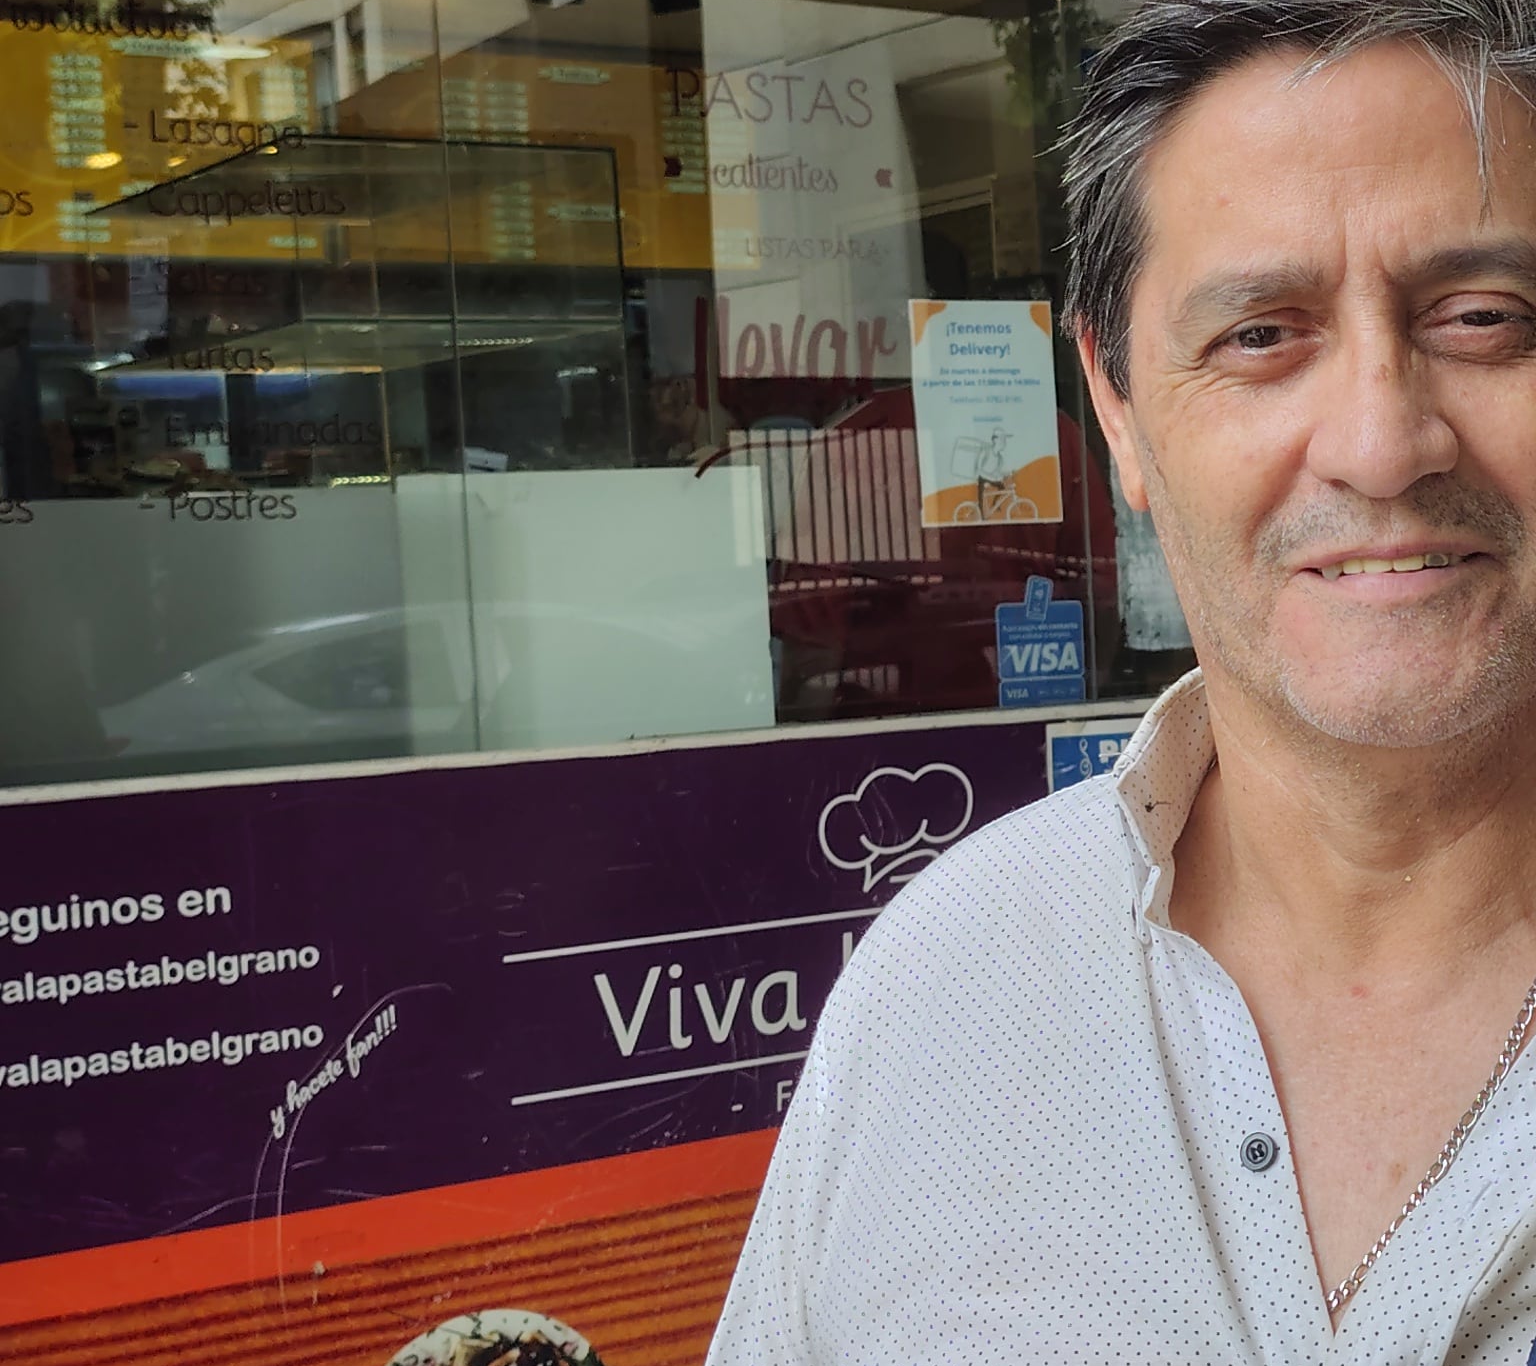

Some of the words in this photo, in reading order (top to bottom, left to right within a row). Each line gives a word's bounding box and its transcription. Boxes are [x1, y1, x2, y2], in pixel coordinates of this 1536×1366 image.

[663, 67, 873, 129] PASTAS
[712, 151, 839, 194] calientes
[746, 237, 815, 261] LISTAS
[694, 295, 897, 396] llevar
[949, 343, 1012, 358] Delivery!
[168, 487, 298, 523] Postres
[1004, 641, 1081, 673] VISA
[177, 885, 232, 919] en
[0, 945, 321, 1006] alapastabelgrano
[593, 963, 808, 1058] Viva
